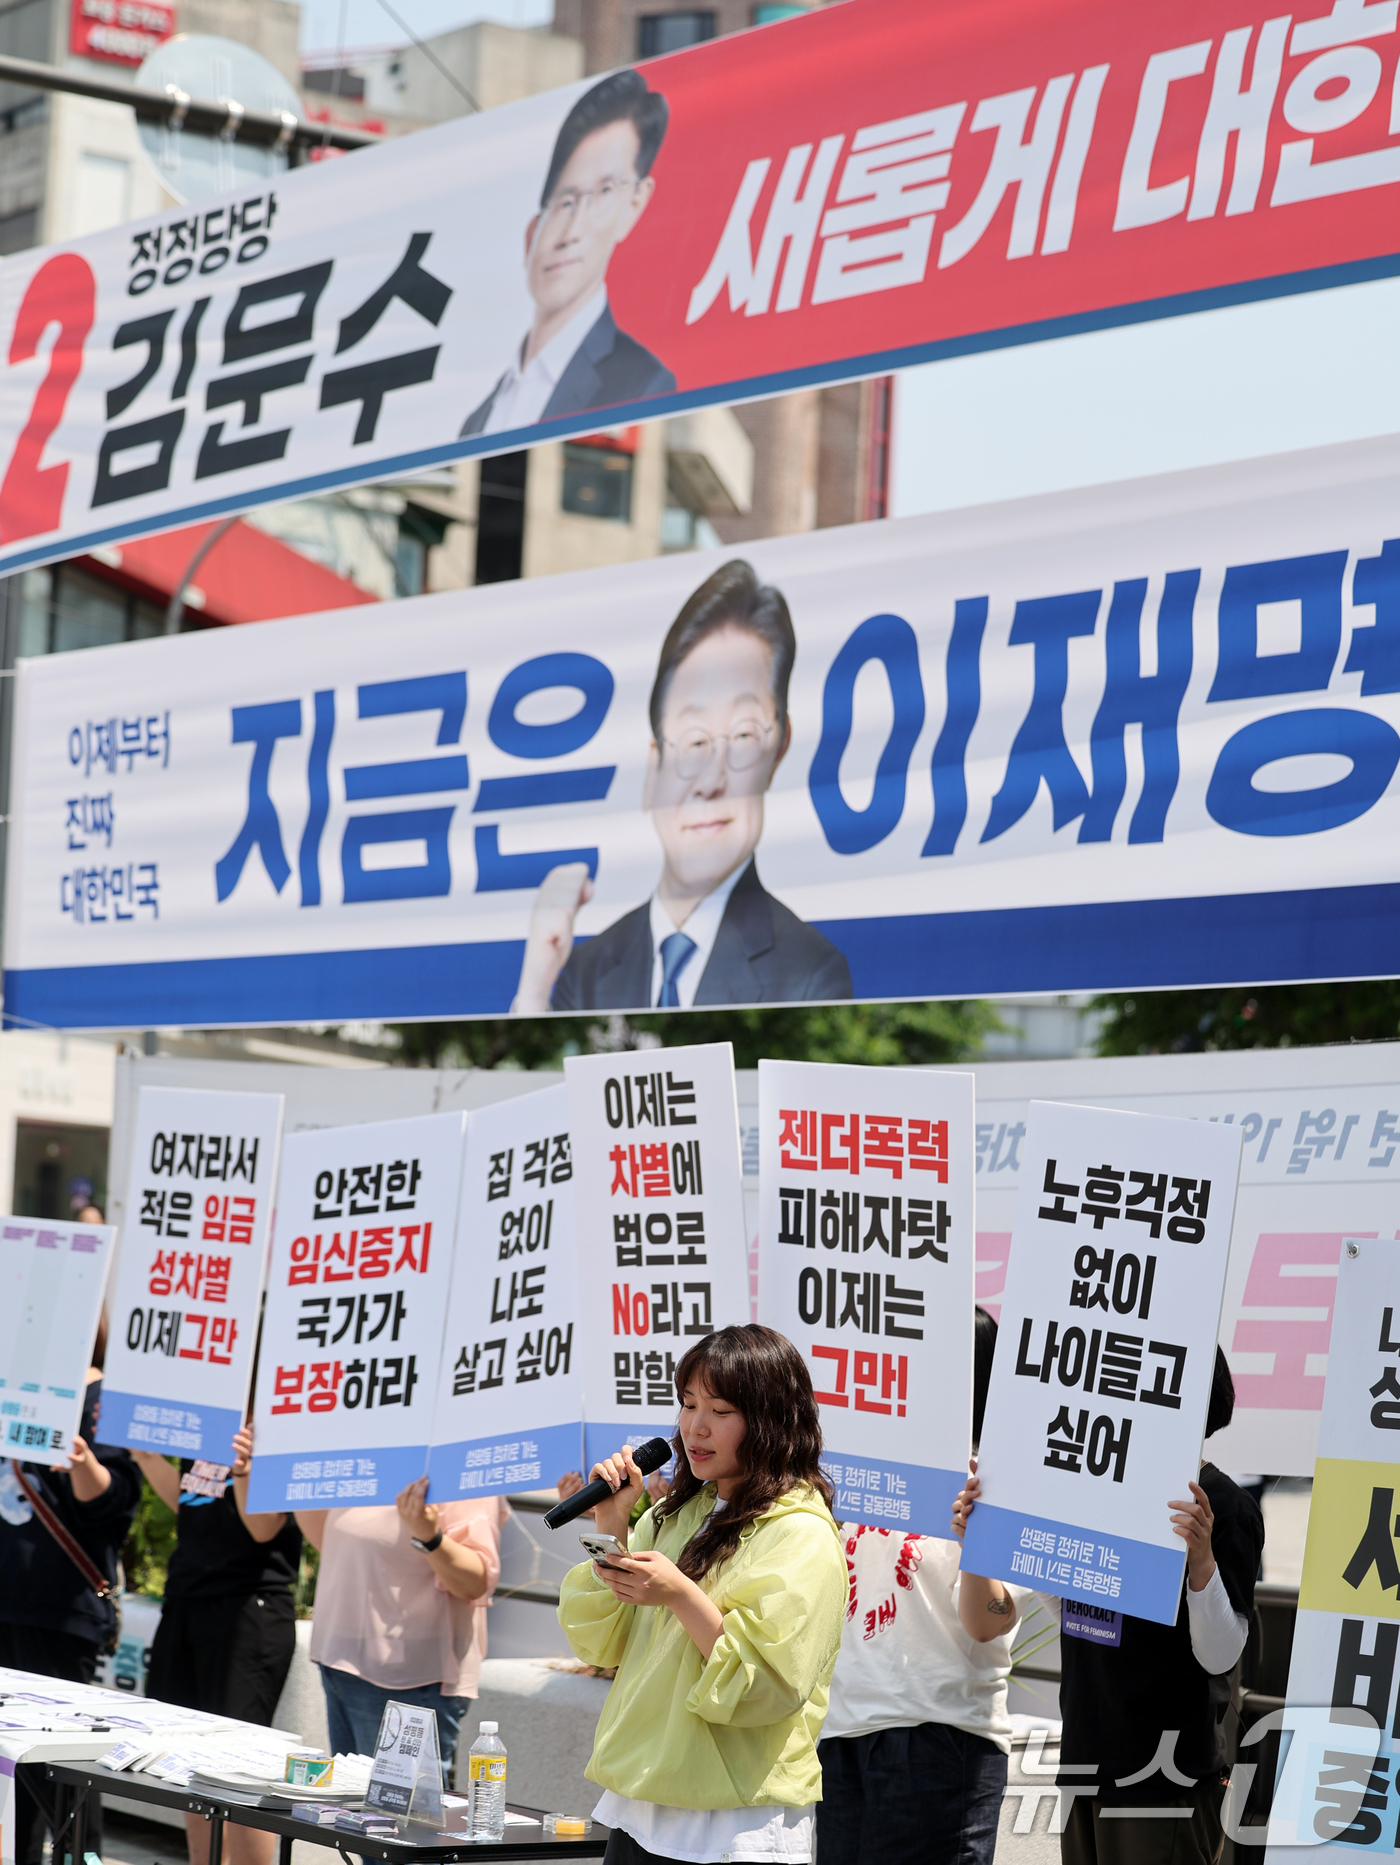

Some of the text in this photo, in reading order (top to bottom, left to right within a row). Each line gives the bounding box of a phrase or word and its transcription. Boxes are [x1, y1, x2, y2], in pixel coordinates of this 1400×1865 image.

[685, 0, 1400, 325] 새롭게 대한
[128, 193, 279, 296] 정정당당
[91, 231, 453, 508] 김문수
[0, 253, 95, 546] 2
[69, 713, 171, 777] 이제부터
[216, 538, 1400, 907] 지금은 이재명
[64, 793, 115, 849] 진짜
[61, 863, 160, 924] 대한민국
[605, 1072, 696, 1128] 이제는
[152, 1133, 258, 1183] 여자라서
[488, 1134, 572, 1201] 집 걱정
[610, 1141, 702, 1197] 차별에
[779, 1110, 948, 1183] 젠더폭력
[141, 1190, 255, 1244] 적은 임금
[314, 1160, 421, 1219] 안전한
[1038, 1159, 1211, 1244] 노후걱정
[288, 1222, 431, 1285] 임신중지
[499, 1200, 552, 1260] 없이
[614, 1212, 706, 1266] 법으로
[779, 1188, 951, 1263] 피해자탓
[150, 1250, 231, 1302] 성차별
[491, 1266, 545, 1323] 나도
[799, 1267, 924, 1340] 이제는
[1070, 1246, 1156, 1319] 없이
[298, 1291, 406, 1347] 국가가
[613, 1283, 714, 1337] No라고
[272, 1356, 417, 1414] 보장하라
[453, 1323, 572, 1395] 살고 싶어
[615, 1351, 673, 1405] 말할
[812, 1345, 907, 1417] 그만!
[1015, 1318, 1187, 1409] 나이들고
[1044, 1406, 1132, 1483] 싶어
[818, 1462, 907, 1495] 평등 정치로 가는
[863, 1493, 911, 1521] 공동행동
[1010, 1550, 1122, 1598] 페미니스트 공동행동
[1020, 1527, 1121, 1571] 성평등 정치로 가는
[1066, 1599, 1116, 1623] DEMOCRACY
[1081, 1625, 1090, 1634] FOR
[1090, 1627, 1116, 1639] FEMINISM
